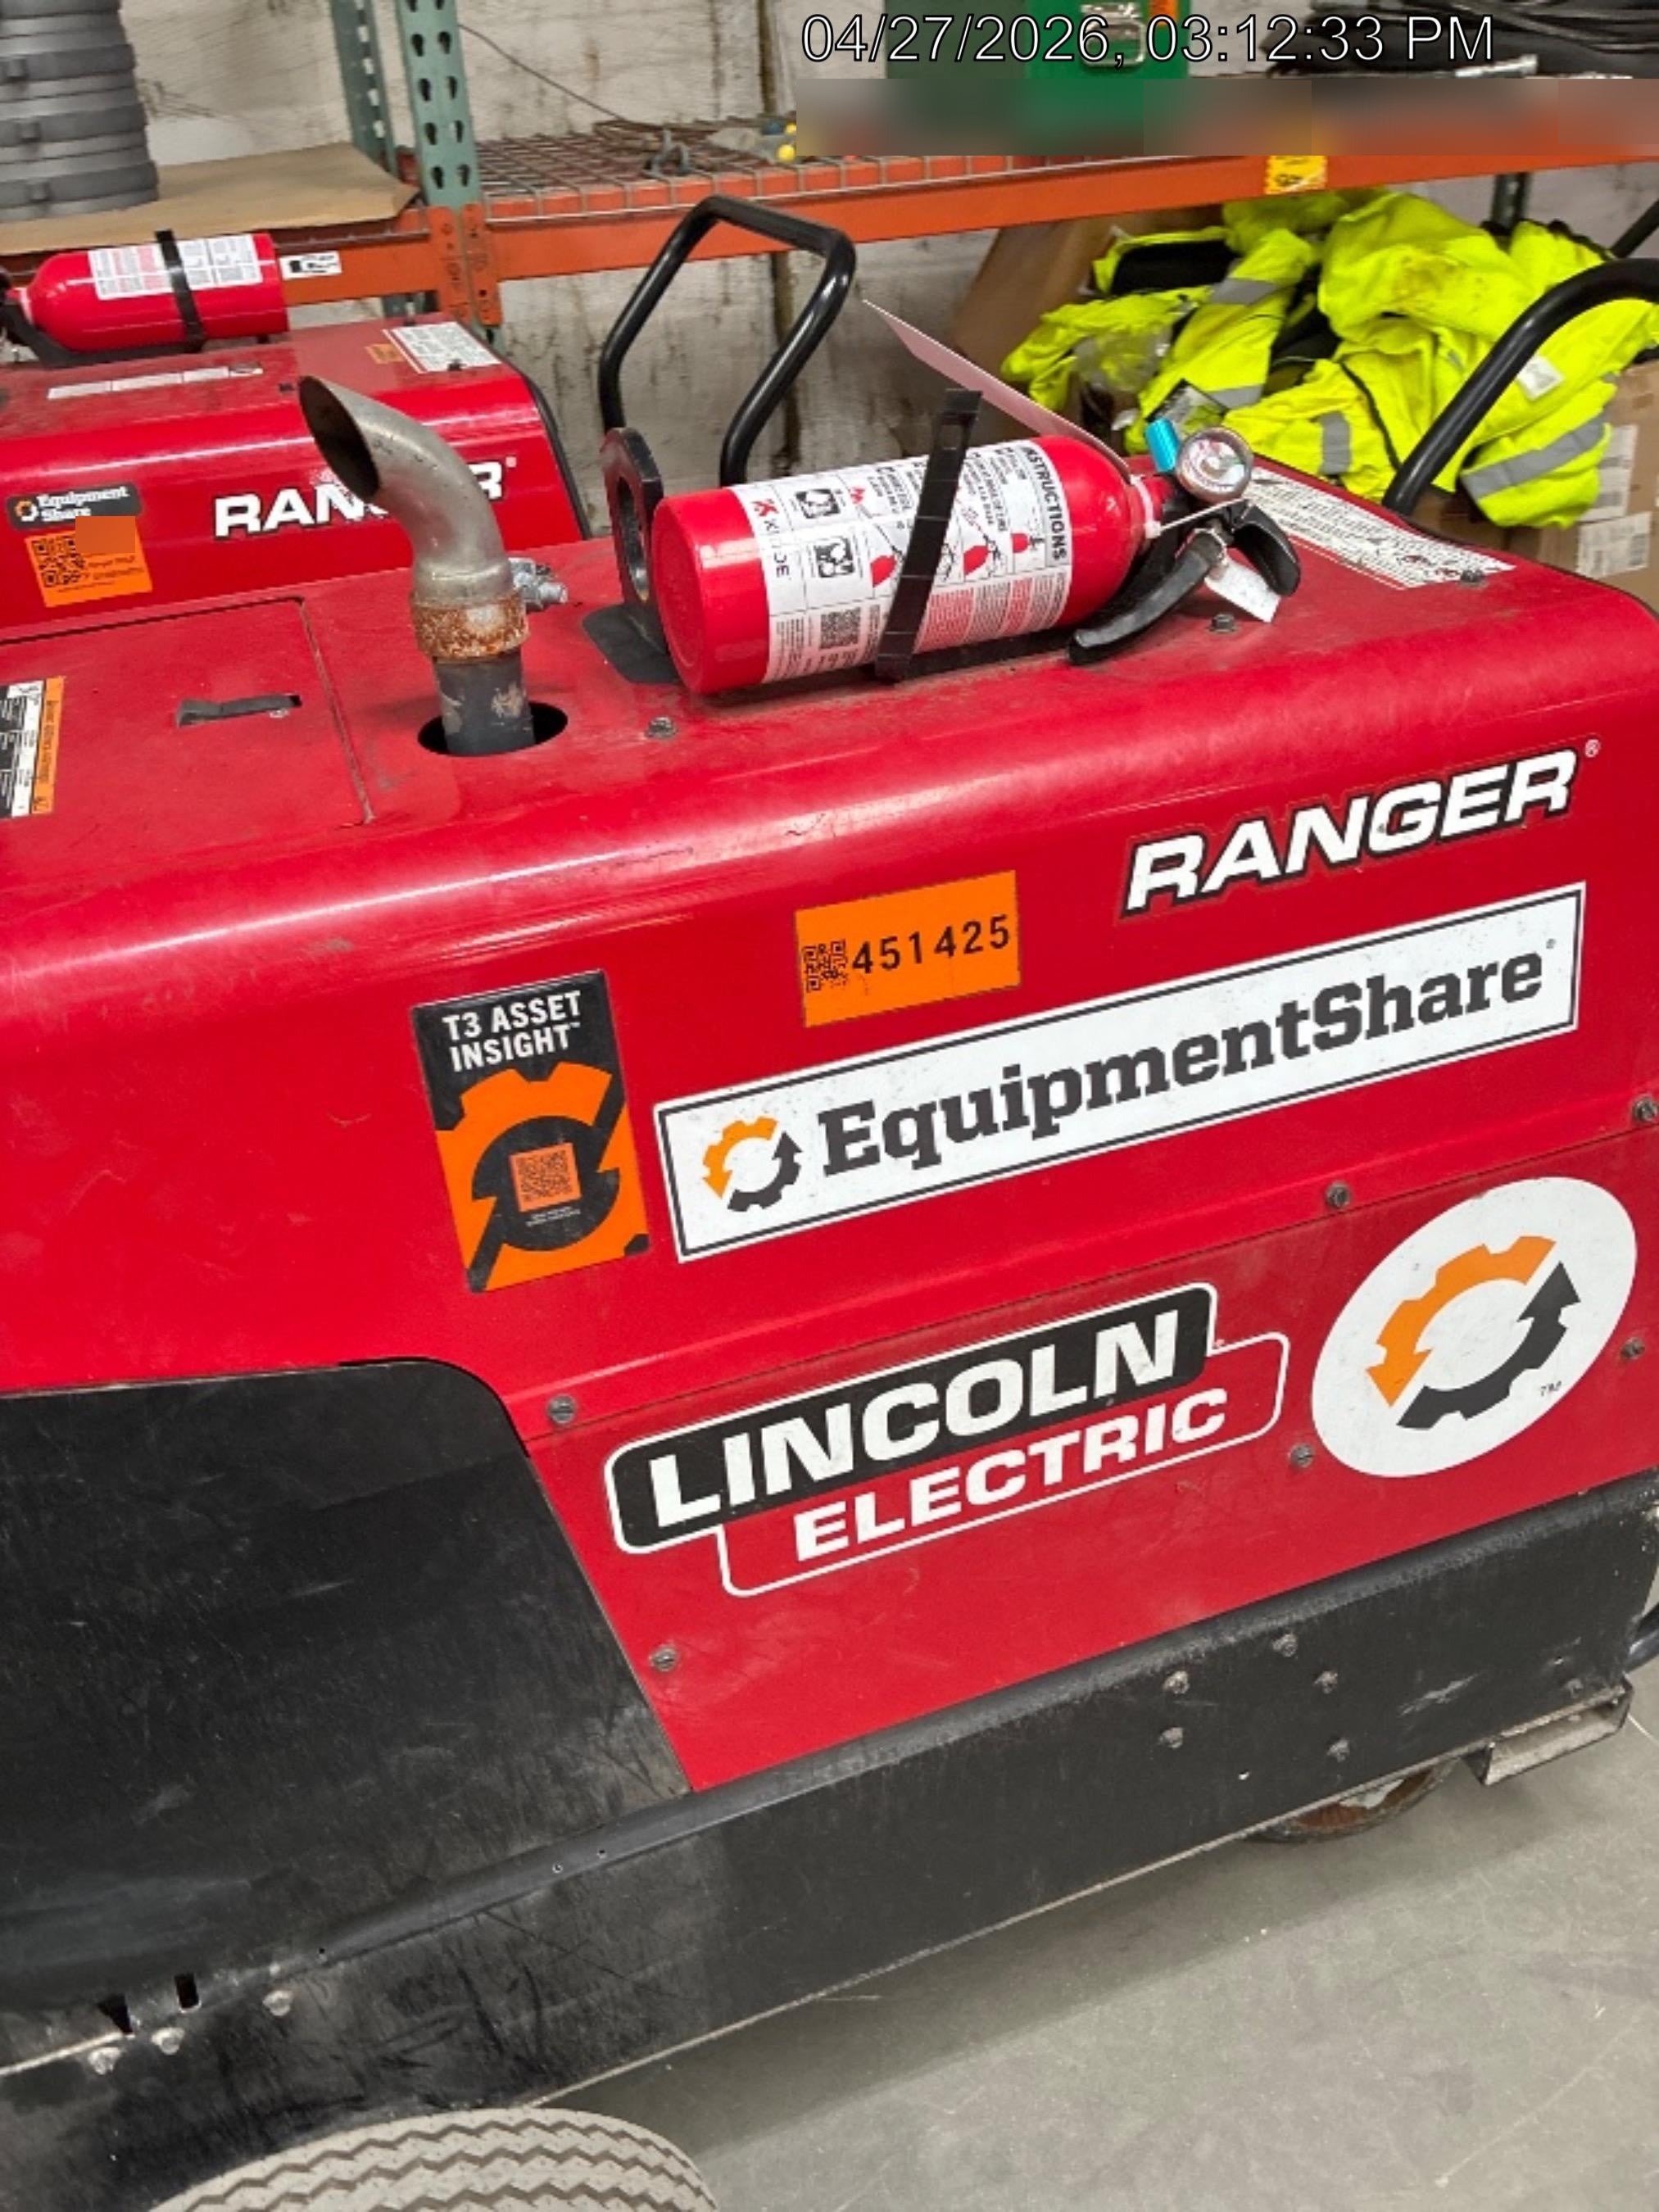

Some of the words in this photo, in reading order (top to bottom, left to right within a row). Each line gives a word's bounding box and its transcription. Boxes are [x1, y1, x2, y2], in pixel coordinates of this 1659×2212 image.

[214, 460, 503, 537] RANR
[1122, 747, 1578, 914] RANGER
[852, 913, 1010, 974] 451425
[442, 1012, 482, 1042] T3
[492, 990, 582, 1032] ASSET
[450, 1025, 573, 1072] INSIGHT
[819, 954, 1543, 1176] EquipmentShare
[649, 1309, 1179, 1529] LINCOLN
[794, 1388, 1228, 1562] ELECTRIC
